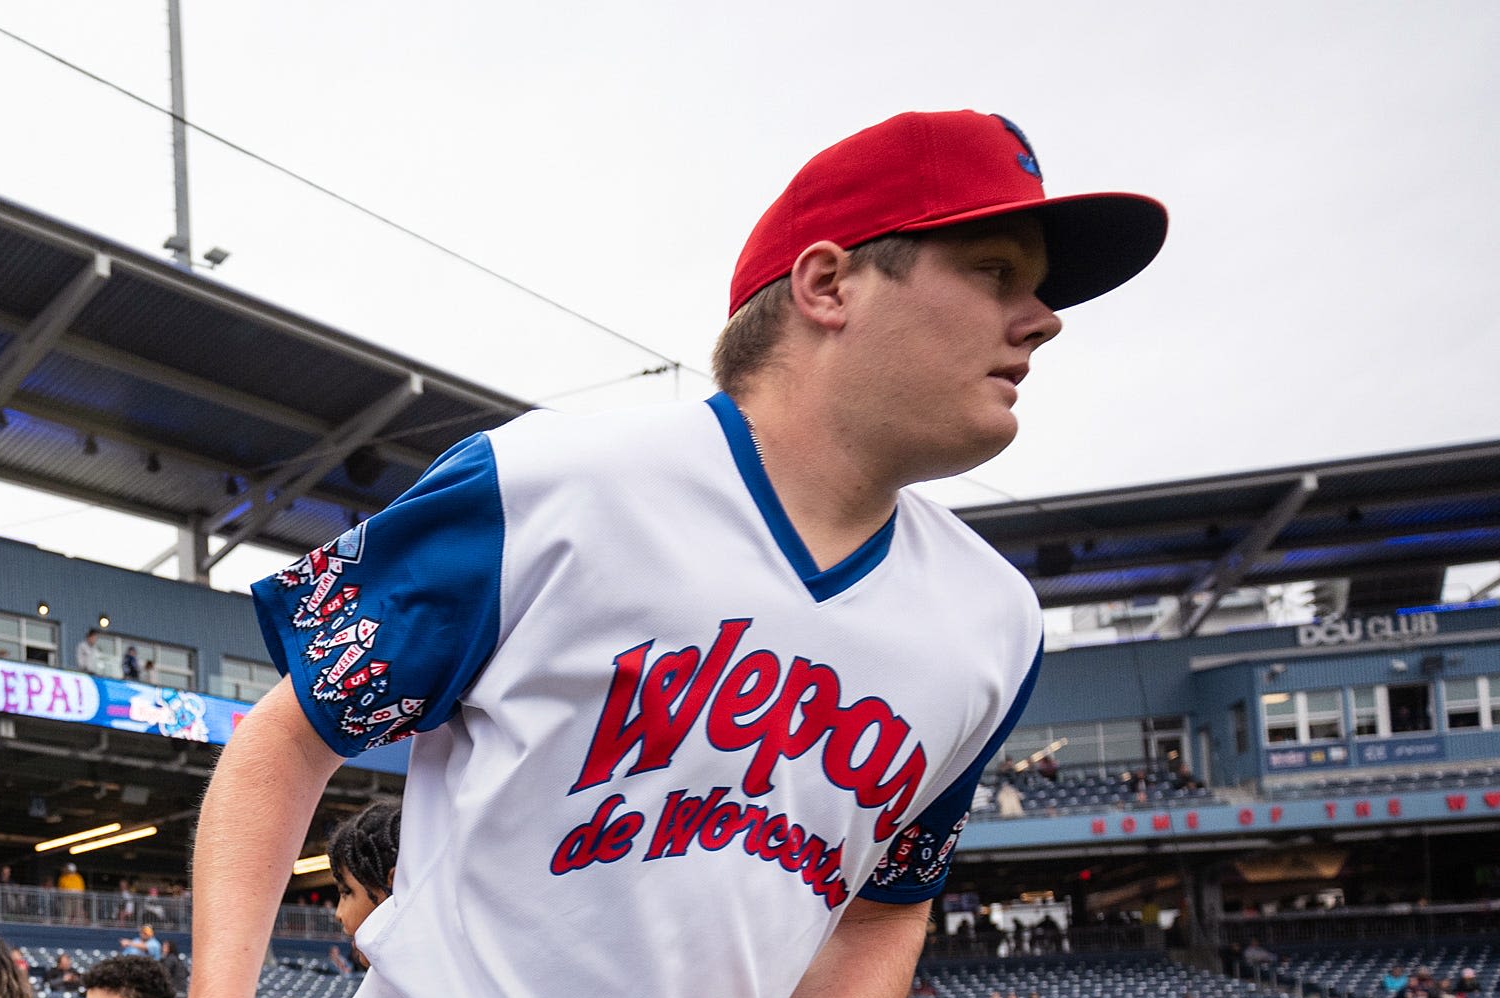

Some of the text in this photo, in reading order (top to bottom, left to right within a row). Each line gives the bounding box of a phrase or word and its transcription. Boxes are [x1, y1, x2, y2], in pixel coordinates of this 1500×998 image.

[1298, 613, 1438, 646] DCU CLUB
[566, 616, 927, 843] Wepas
[550, 793, 646, 877] de
[1091, 810, 1199, 835] HOME
[1238, 806, 1283, 825] OF
[1323, 797, 1401, 819] THE
